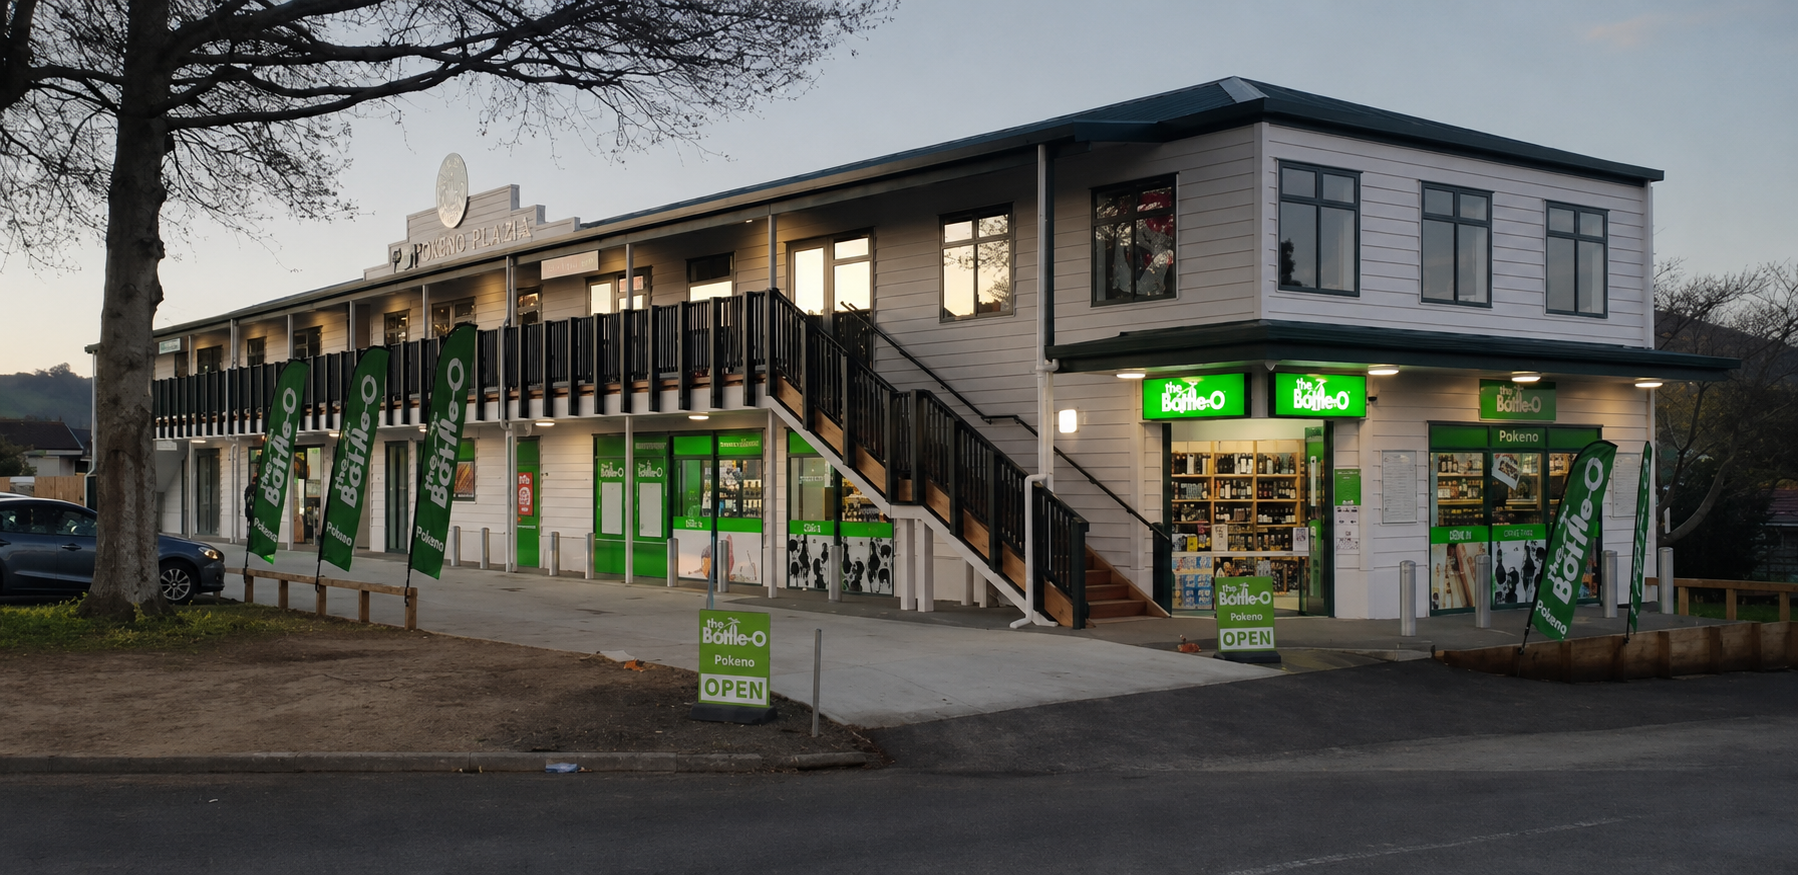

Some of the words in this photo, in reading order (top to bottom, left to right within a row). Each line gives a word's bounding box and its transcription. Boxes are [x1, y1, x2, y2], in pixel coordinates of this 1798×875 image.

[1165, 381, 1182, 394] the
[1296, 378, 1313, 391] the
[1499, 430, 1539, 443] Pokeno
[1552, 457, 1604, 605] Bottle-O
[1548, 548, 1563, 582] the
[1222, 584, 1237, 592] the
[1219, 588, 1272, 606] Bottle-O
[706, 618, 724, 628] the
[1230, 612, 1263, 621] Pokeno
[702, 625, 767, 647] Bottle-O
[1222, 630, 1271, 646] OPEN
[714, 654, 755, 667] Pokeno
[704, 678, 763, 699] OPEN
